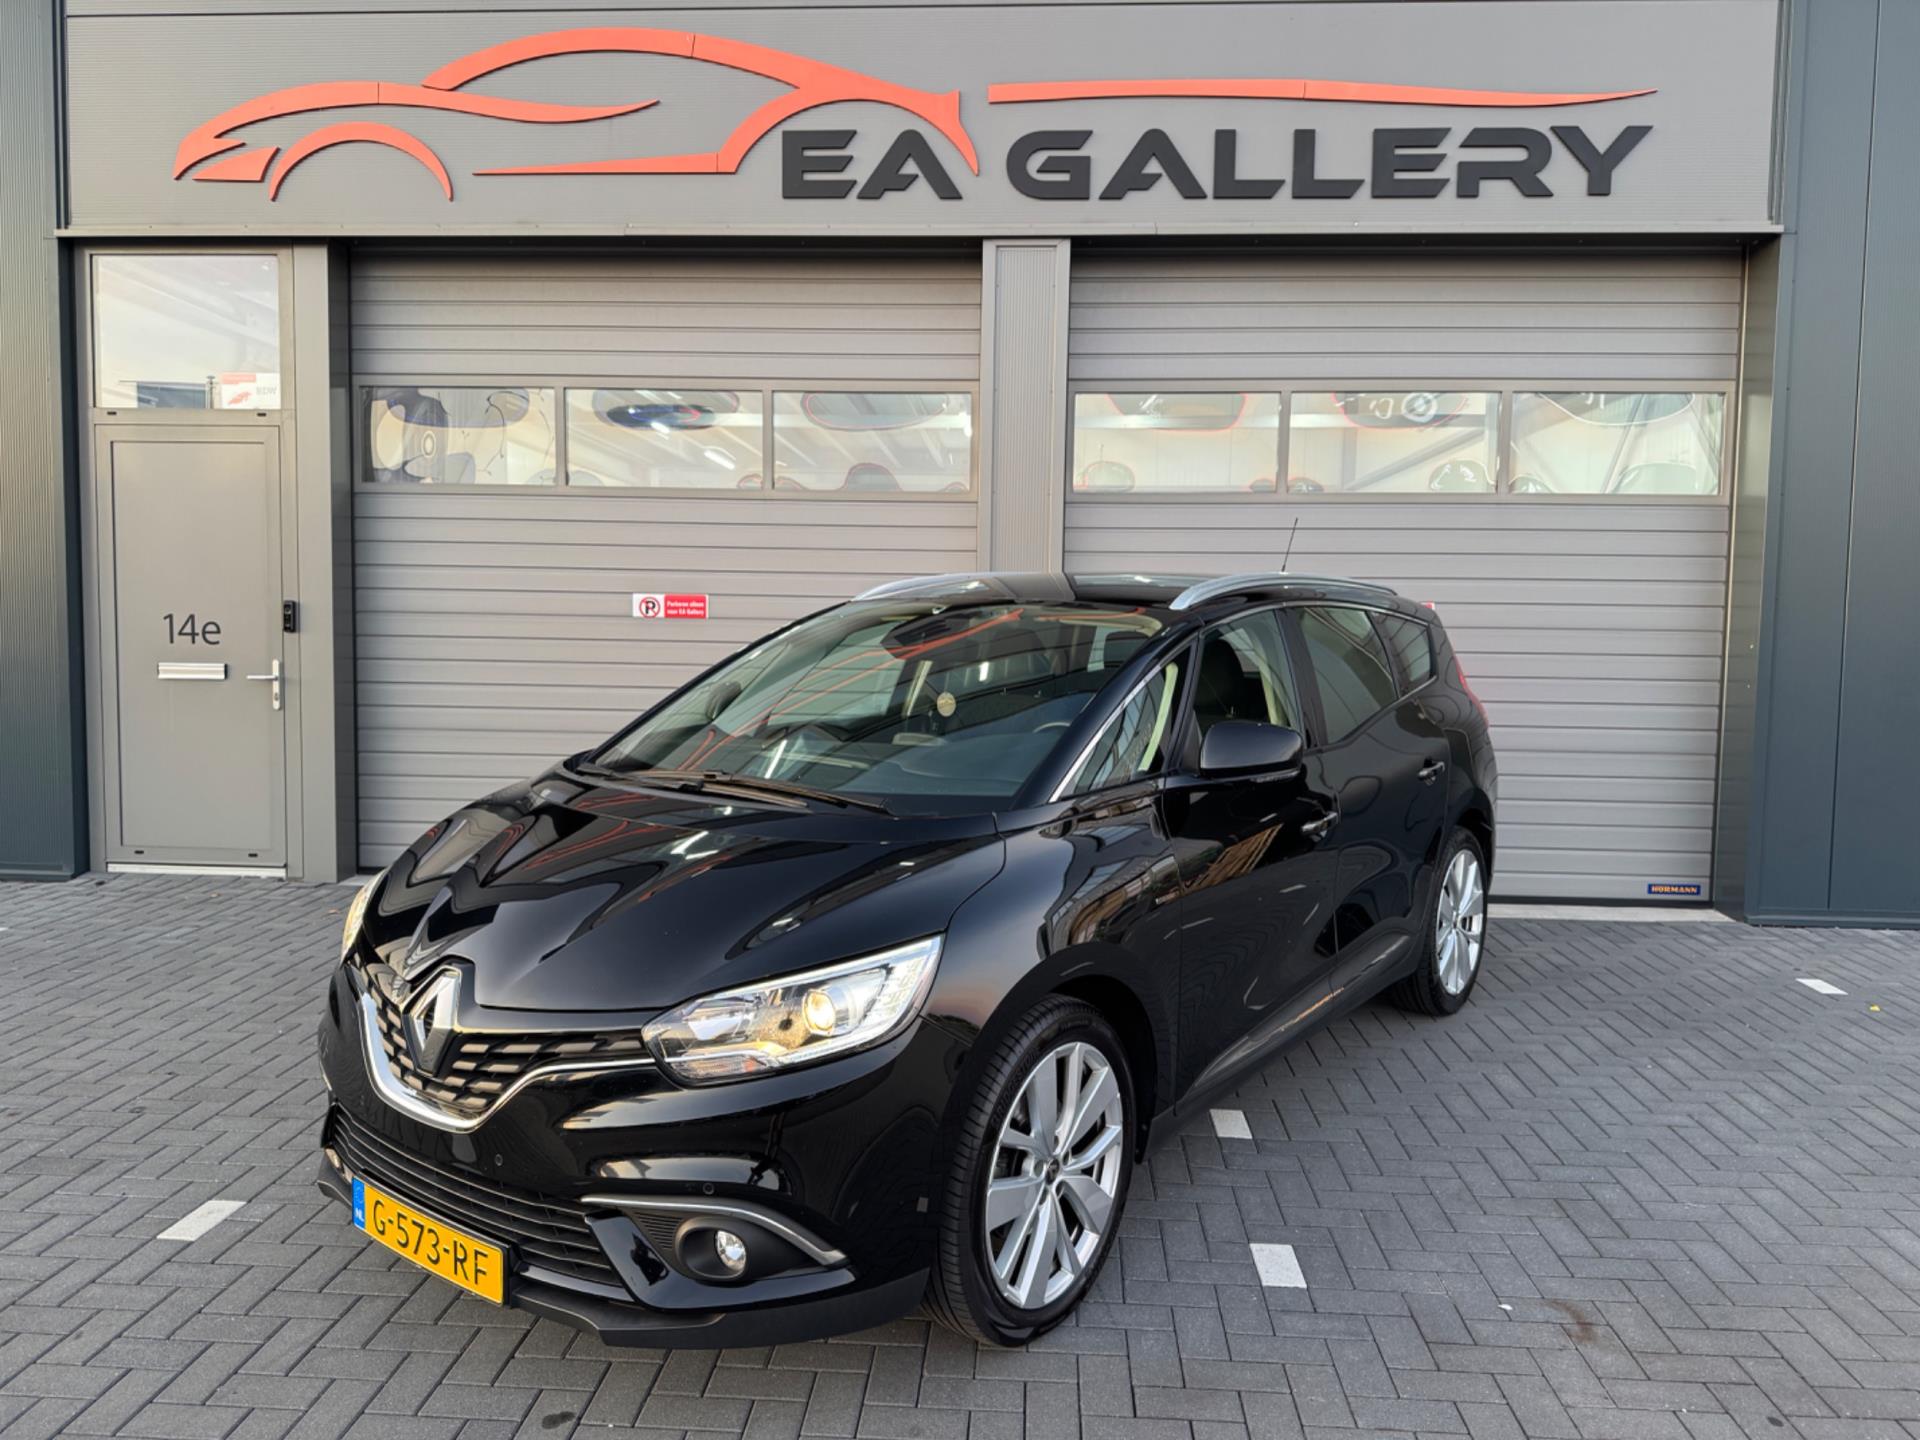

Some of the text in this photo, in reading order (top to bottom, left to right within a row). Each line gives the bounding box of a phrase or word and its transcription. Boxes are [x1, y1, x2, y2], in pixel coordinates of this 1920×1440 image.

[781, 124, 1655, 202] EA GALLERY
[163, 612, 222, 645] 14e
[355, 1207, 364, 1222] NL
[373, 1199, 489, 1286] G-573-RF
